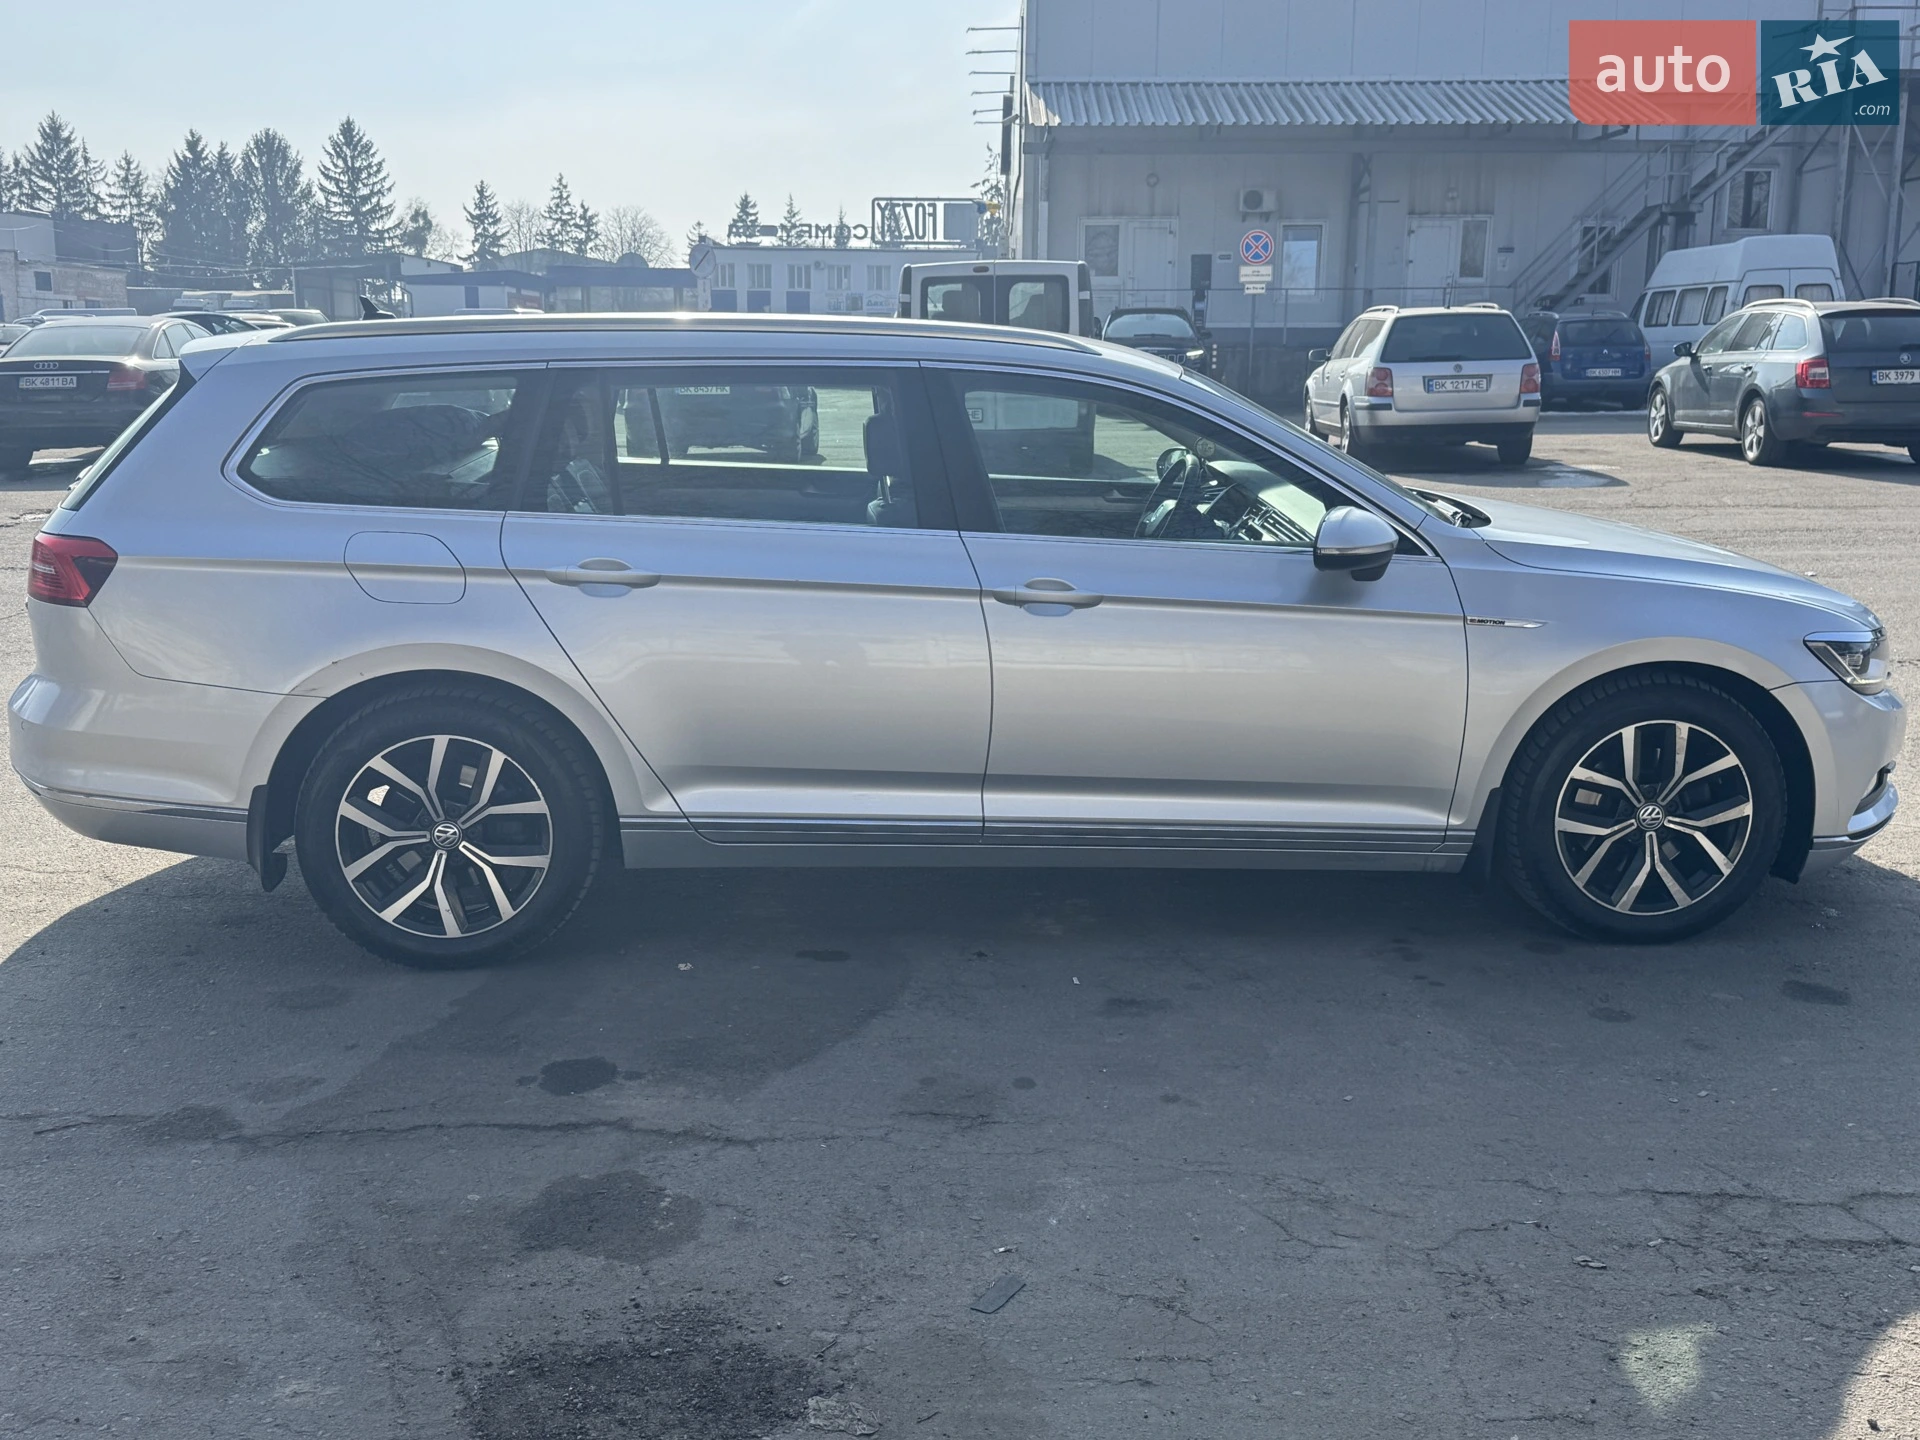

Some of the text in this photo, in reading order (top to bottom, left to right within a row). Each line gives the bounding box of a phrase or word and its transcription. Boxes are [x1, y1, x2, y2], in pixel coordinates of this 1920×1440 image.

[1878, 371, 1892, 381] BK
[1893, 370, 1915, 381] 3979
[24, 377, 75, 387] BK 4811 BA
[1434, 379, 1485, 390] BK 1217 HE
